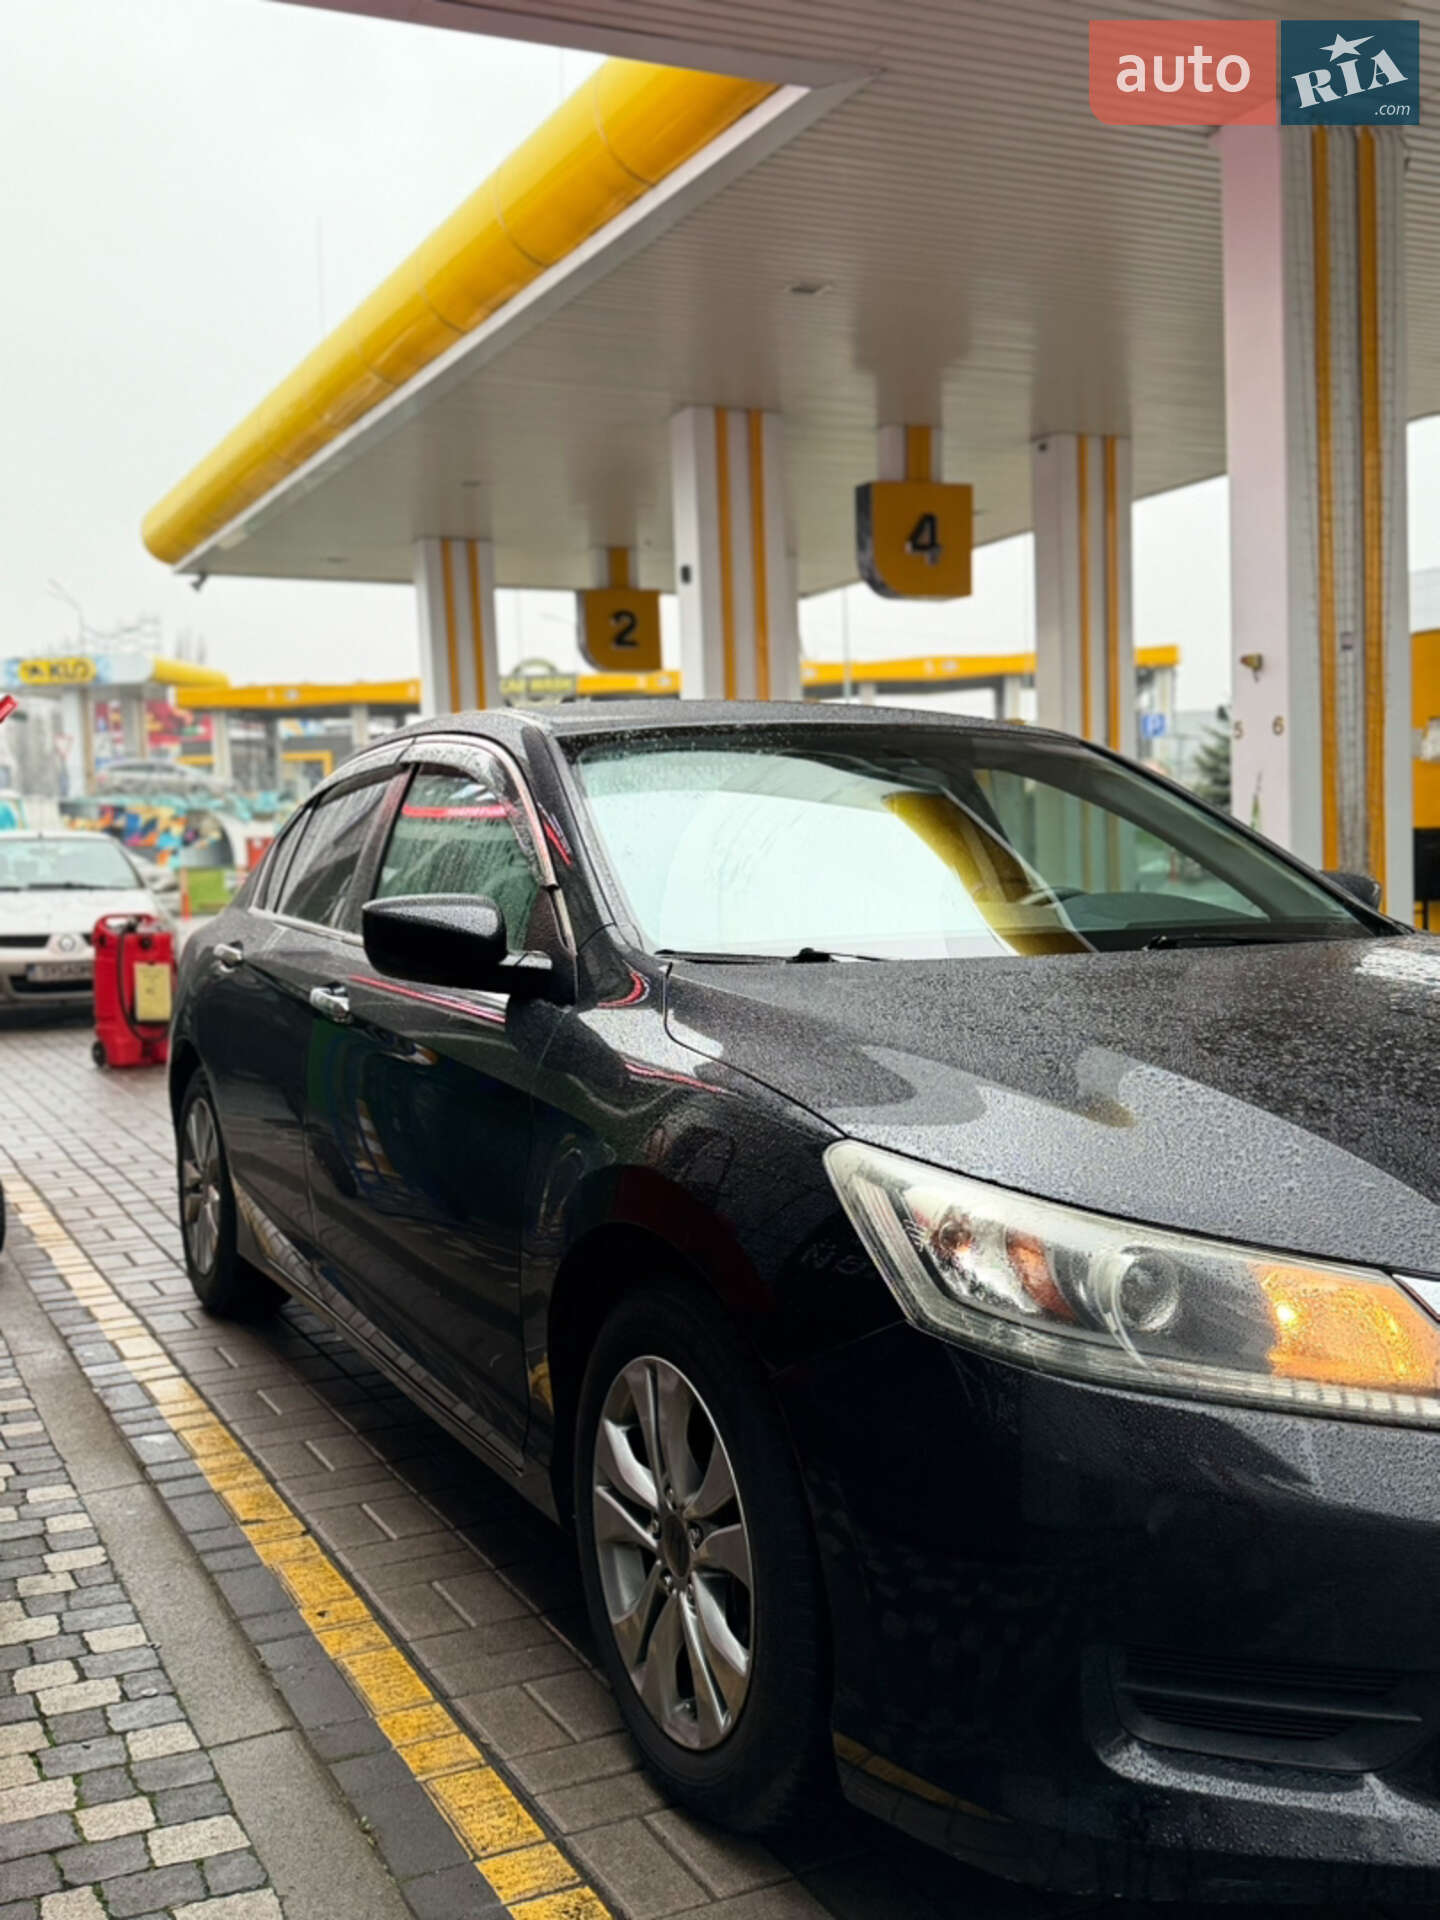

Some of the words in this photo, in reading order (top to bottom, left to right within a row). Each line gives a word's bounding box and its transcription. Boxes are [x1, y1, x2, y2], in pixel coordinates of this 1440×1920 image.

[907, 512, 941, 566] 4
[612, 609, 638, 647] 2
[1233, 719, 1244, 740] 5
[1271, 714, 1285, 737] 6
